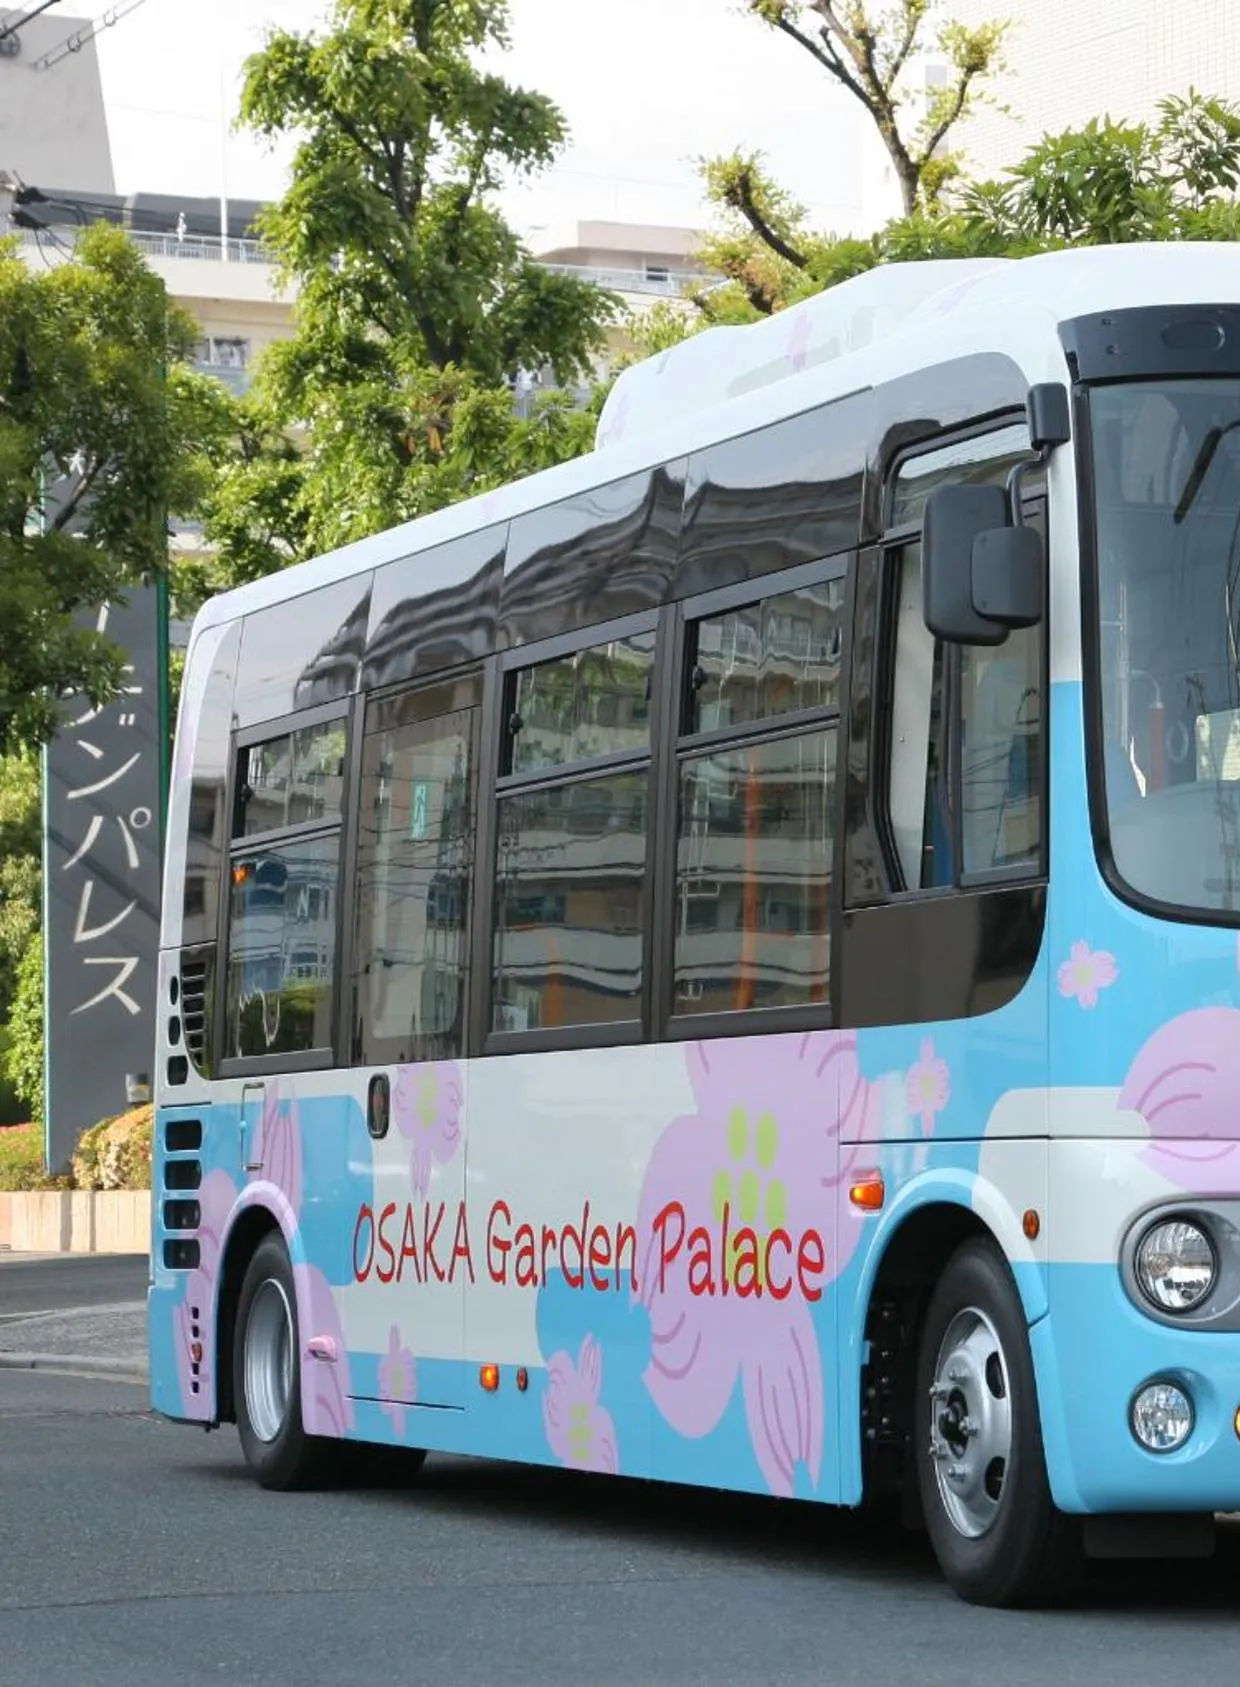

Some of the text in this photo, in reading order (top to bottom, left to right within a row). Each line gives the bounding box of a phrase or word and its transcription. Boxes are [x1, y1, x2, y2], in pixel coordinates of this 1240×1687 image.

[352, 1200, 825, 1302] OSAKA Garden Palace
